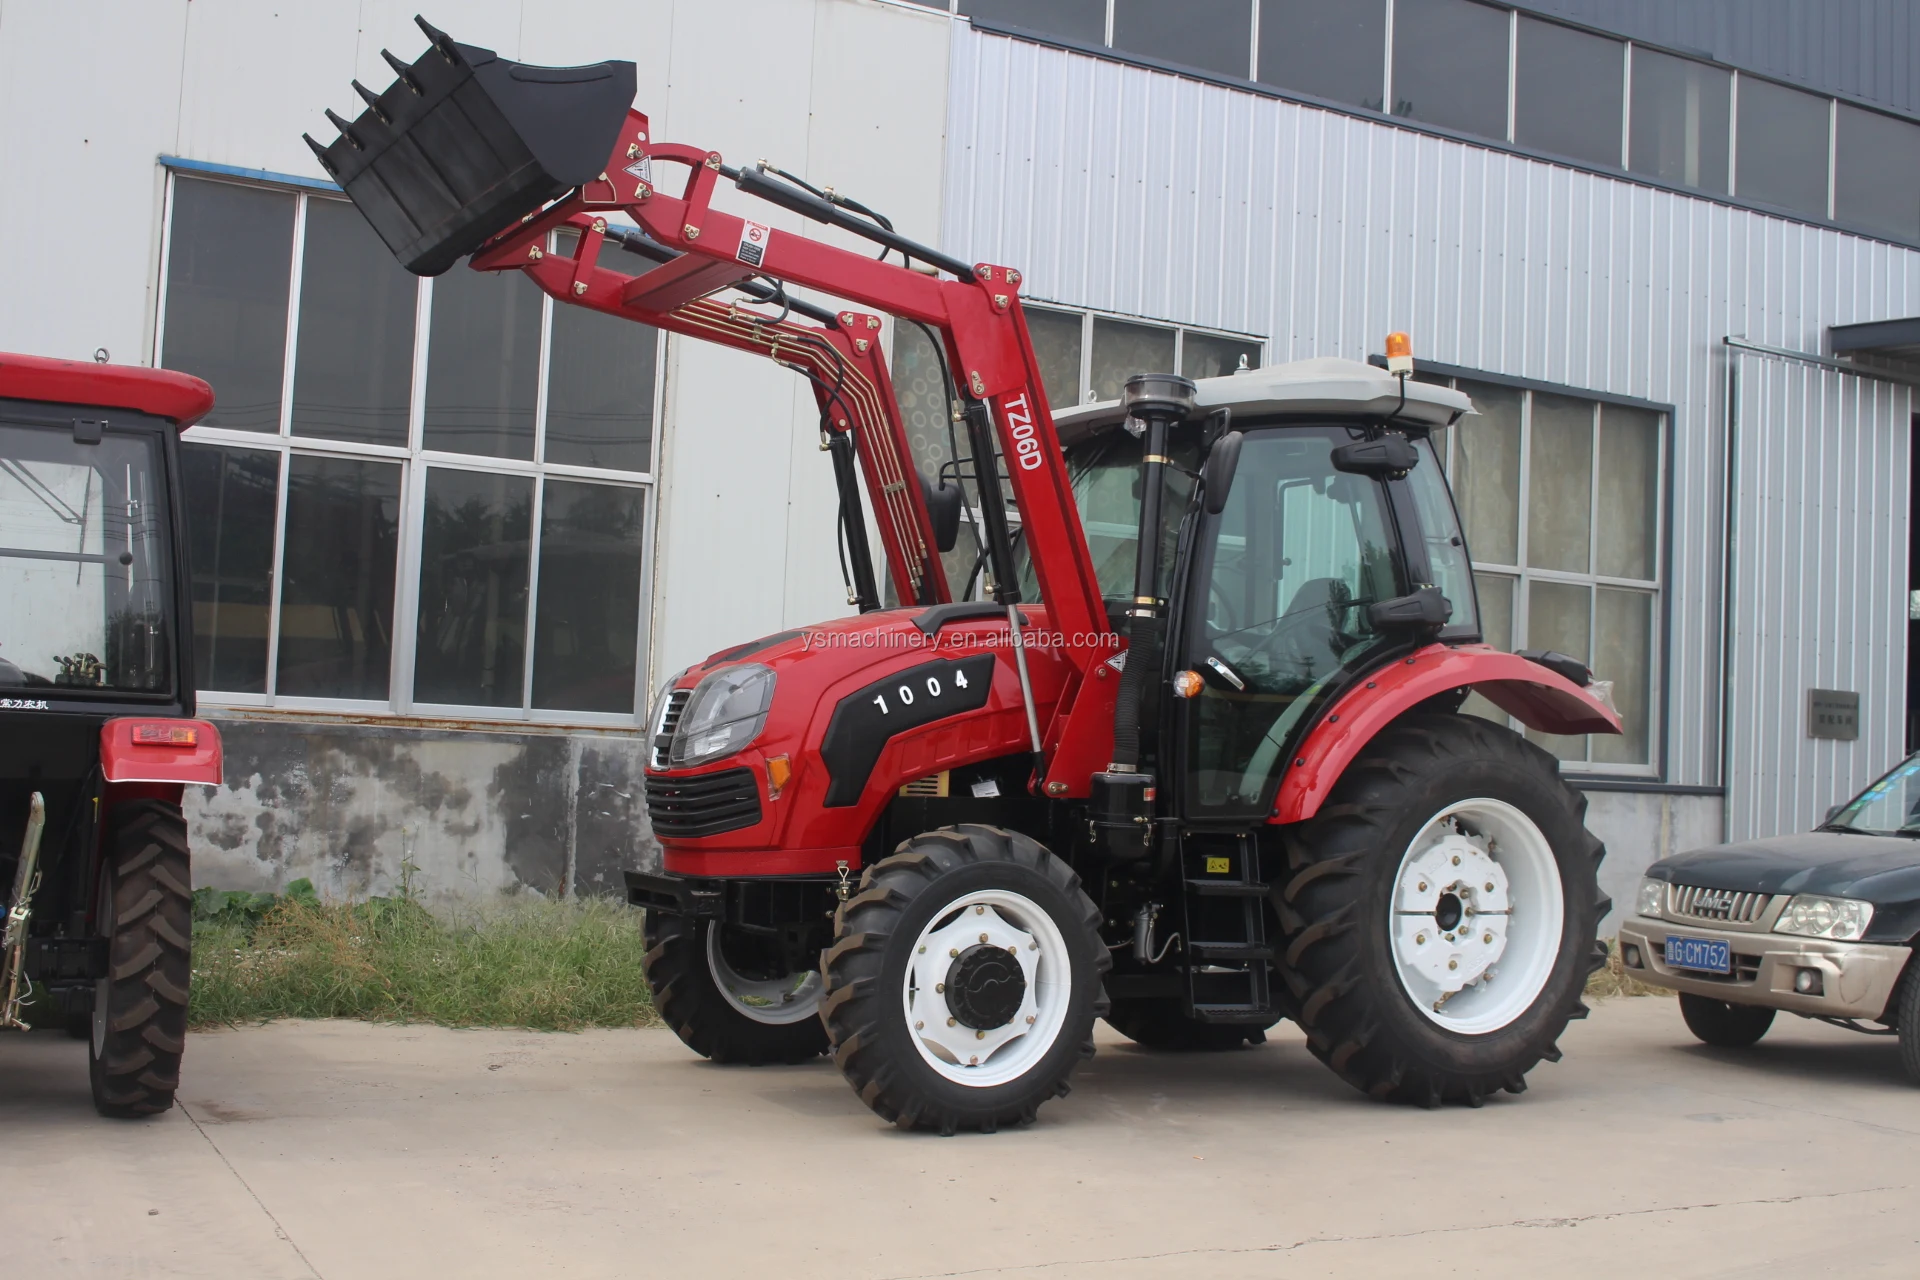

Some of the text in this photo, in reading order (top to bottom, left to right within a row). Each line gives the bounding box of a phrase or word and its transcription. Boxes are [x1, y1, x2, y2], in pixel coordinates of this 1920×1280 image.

[1004, 392, 1043, 471] TZ06D
[873, 669, 968, 715] 1004
[1691, 895, 1732, 911] JMC
